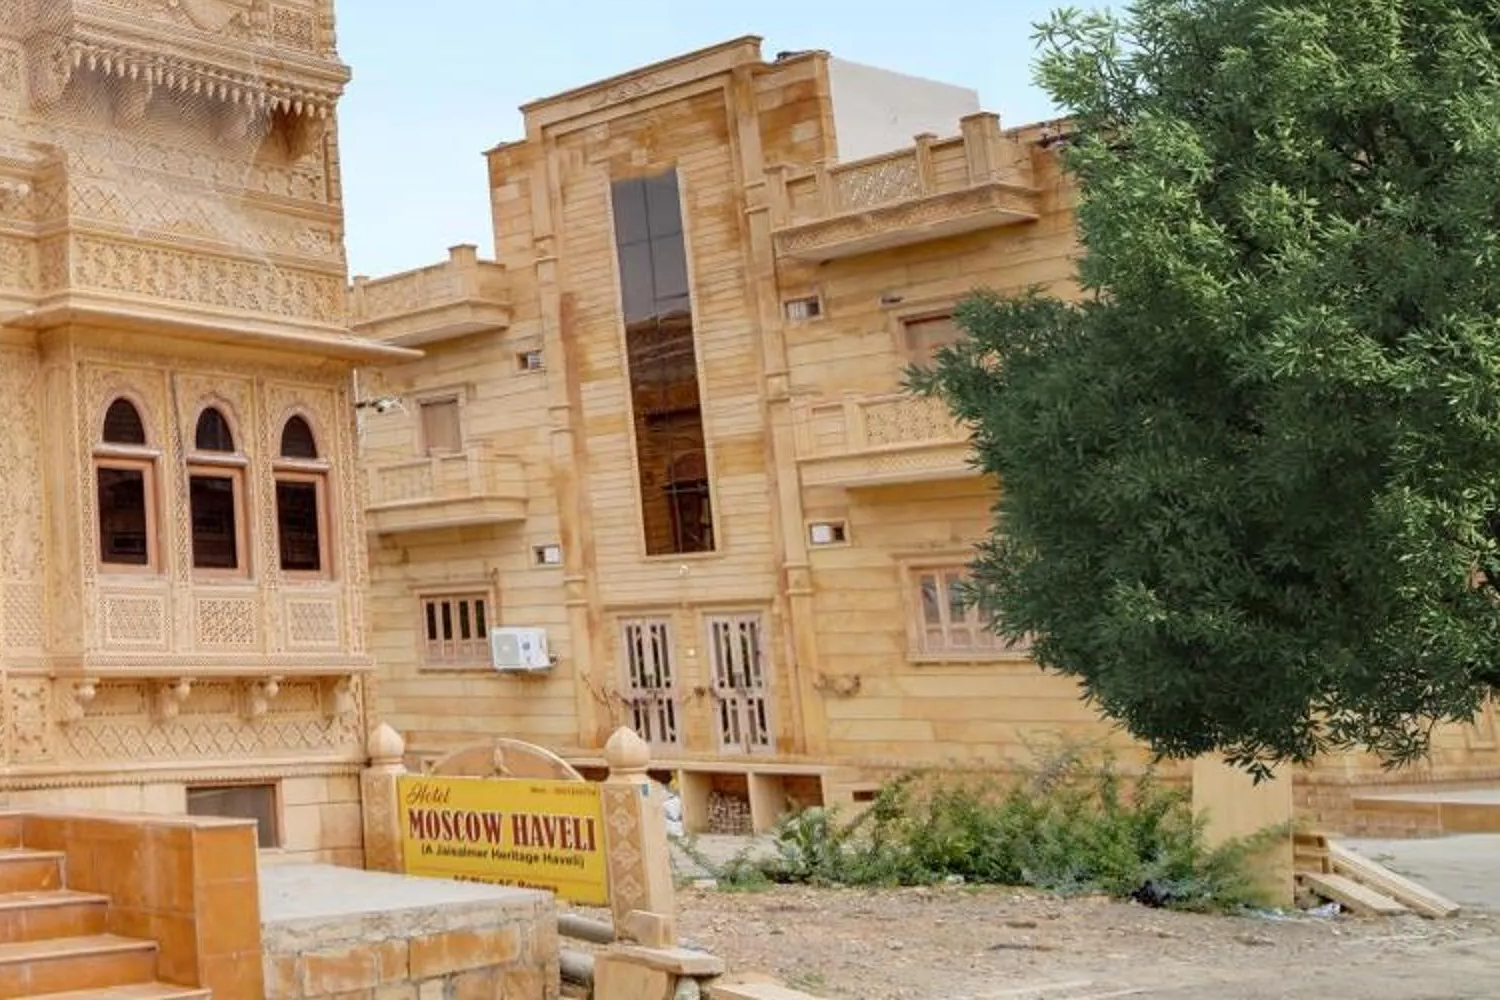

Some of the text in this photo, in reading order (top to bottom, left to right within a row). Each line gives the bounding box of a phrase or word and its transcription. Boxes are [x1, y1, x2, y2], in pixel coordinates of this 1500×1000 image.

[406, 782, 450, 804] Hotel
[408, 808, 596, 851] MOSCOW HAVELI
[436, 844, 488, 859] Jaisalmer
[491, 848, 539, 865] Heritage
[543, 852, 585, 868] Haveli)
